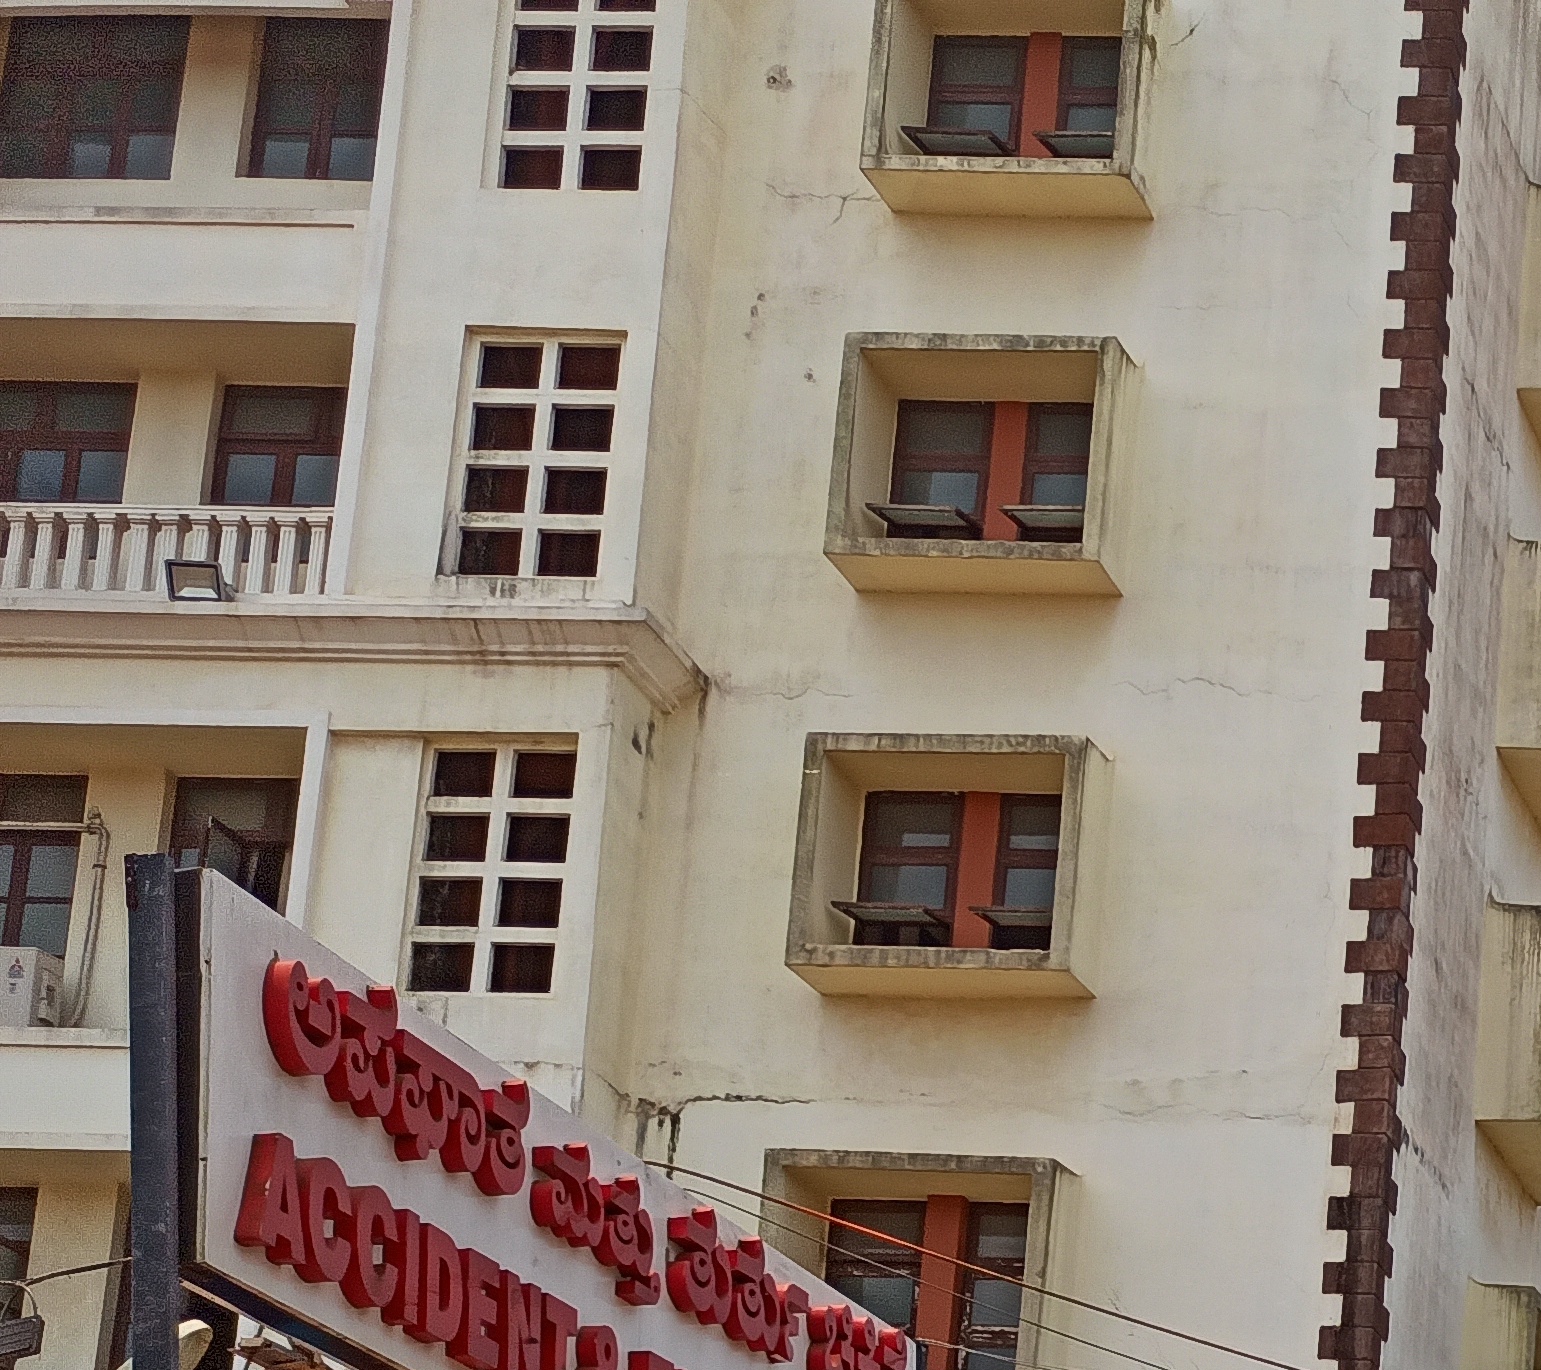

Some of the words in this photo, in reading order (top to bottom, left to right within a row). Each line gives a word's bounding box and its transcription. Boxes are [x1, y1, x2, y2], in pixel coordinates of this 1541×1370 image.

[263, 958, 530, 1196] ಅಪಘಾತ
[530, 1142, 661, 1305] ಮತ್ತು
[666, 1207, 810, 1364] ತುರ್ತು
